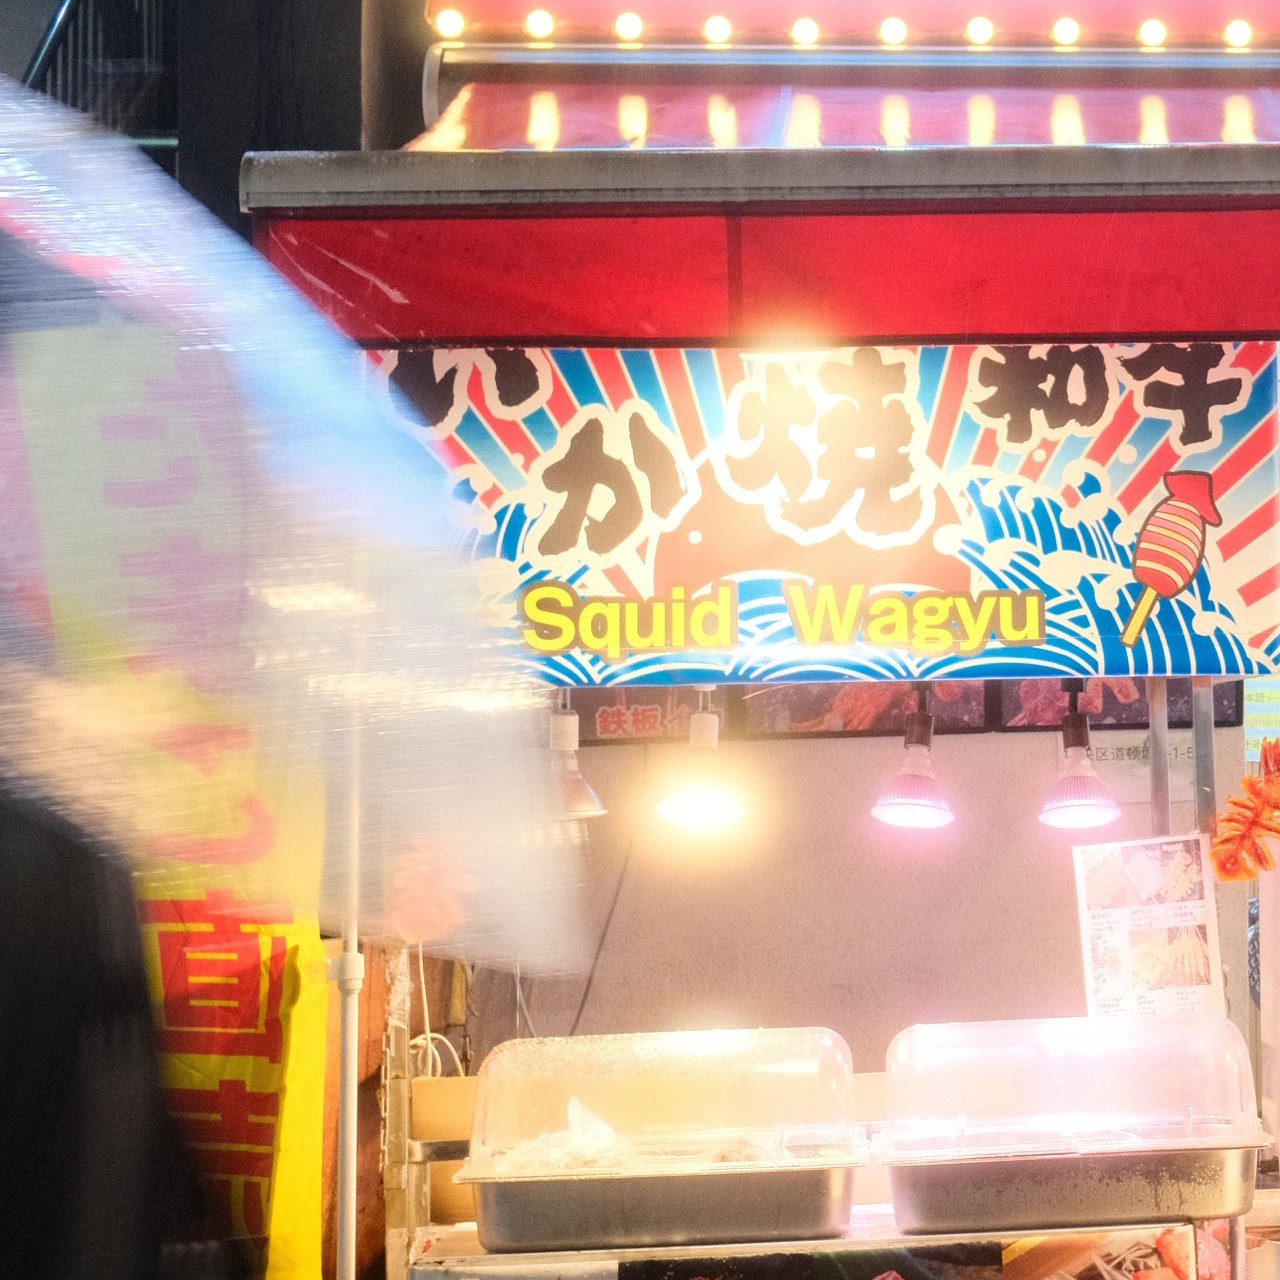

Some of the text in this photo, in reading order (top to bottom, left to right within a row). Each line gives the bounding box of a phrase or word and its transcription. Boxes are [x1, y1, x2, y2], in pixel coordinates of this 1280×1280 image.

[972, 345, 1242, 446] 和牛
[523, 585, 1042, 657] Squid Wagyu
